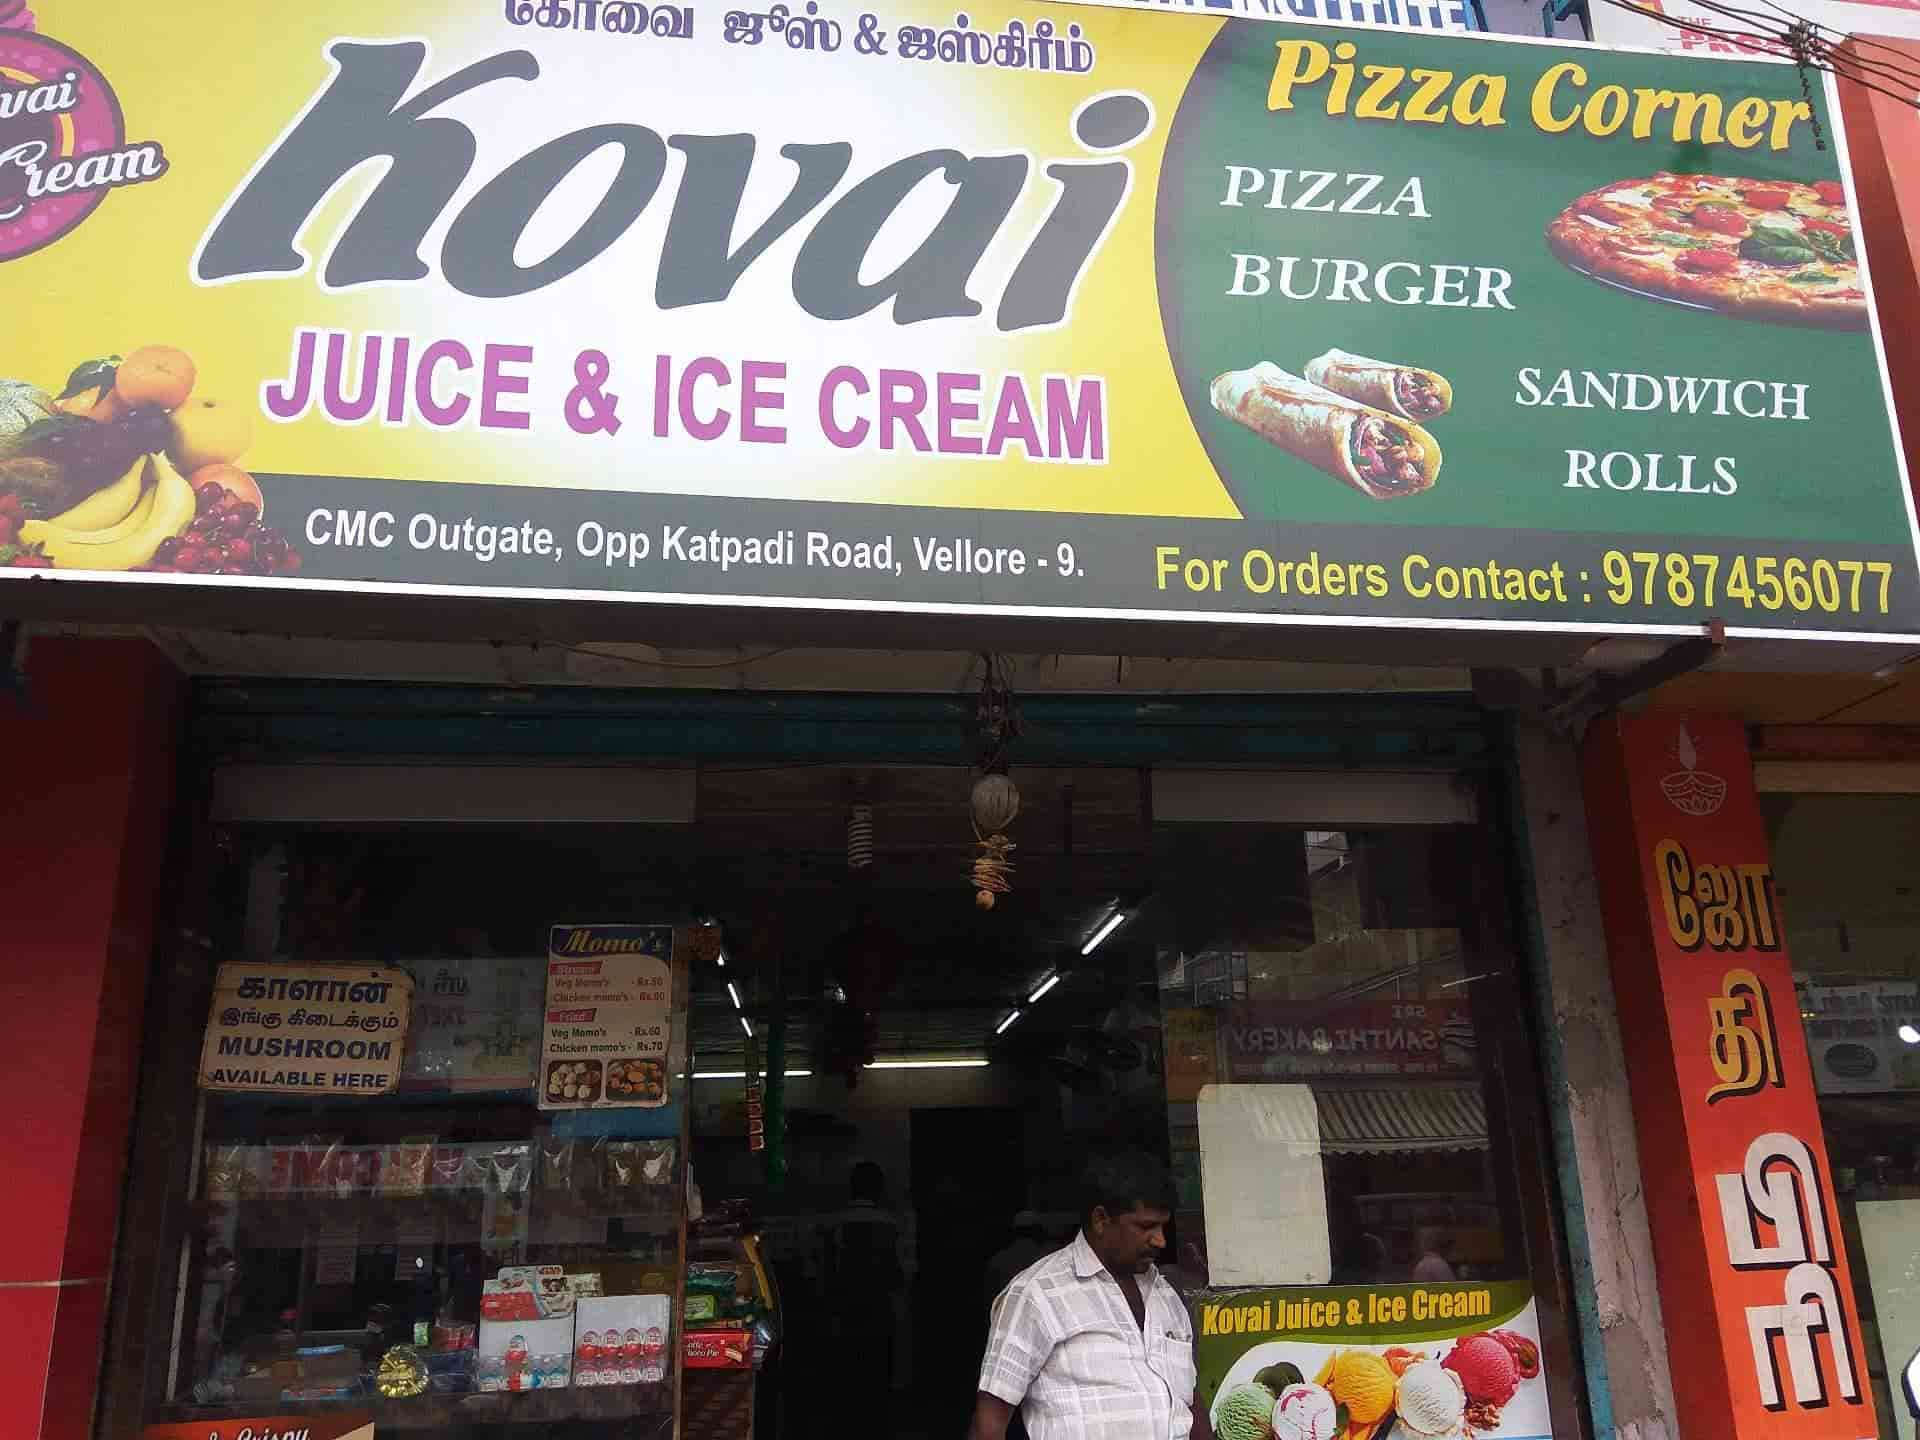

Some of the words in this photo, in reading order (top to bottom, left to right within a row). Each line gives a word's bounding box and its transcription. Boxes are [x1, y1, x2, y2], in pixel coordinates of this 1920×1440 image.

[723, 1, 842, 52] ஜூஸ்
[854, 14, 888, 55] &
[1266, 38, 1508, 126] Pizza
[1530, 61, 1811, 151] Corner
[194, 40, 1153, 332] Kovai
[1220, 165, 1432, 218] PIZZA
[1226, 251, 1517, 311] BURGER
[266, 332, 533, 430] JUICE
[564, 349, 623, 437] &
[653, 354, 787, 444] ICE
[818, 365, 1104, 460] CREAM
[1515, 366, 1811, 421] SANDWICH
[1563, 448, 1738, 495] ROLLS
[305, 508, 394, 548] CMC
[408, 513, 562, 562] Outgate,
[576, 521, 650, 567] Opp
[662, 526, 793, 571] Katpadi
[806, 531, 902, 576] Road,
[913, 537, 1026, 575] Vellore
[1057, 542, 1085, 577] 9.
[1156, 546, 1228, 591] For
[1243, 549, 1388, 598] Orders
[1401, 554, 1567, 604] Contact
[1582, 569, 1592, 603] :
[1601, 550, 1893, 613] 9787456077
[237, 971, 393, 1004] காளான்
[222, 1007, 282, 1030] இங்கு
[551, 1027, 569, 1040] Veg
[217, 1036, 392, 1062] MUSHROOM
[550, 1042, 589, 1053] Chicken
[637, 1041, 663, 1052] Rs.70
[211, 1068, 325, 1087] AVAILABLE
[332, 1073, 389, 1088] HERE
[1203, 1304, 1271, 1336] Kovai
[1276, 1297, 1339, 1331] Juice
[1345, 1300, 1363, 1326] &
[1369, 1293, 1408, 1323] Ice
[1412, 1289, 1491, 1320] Cream
